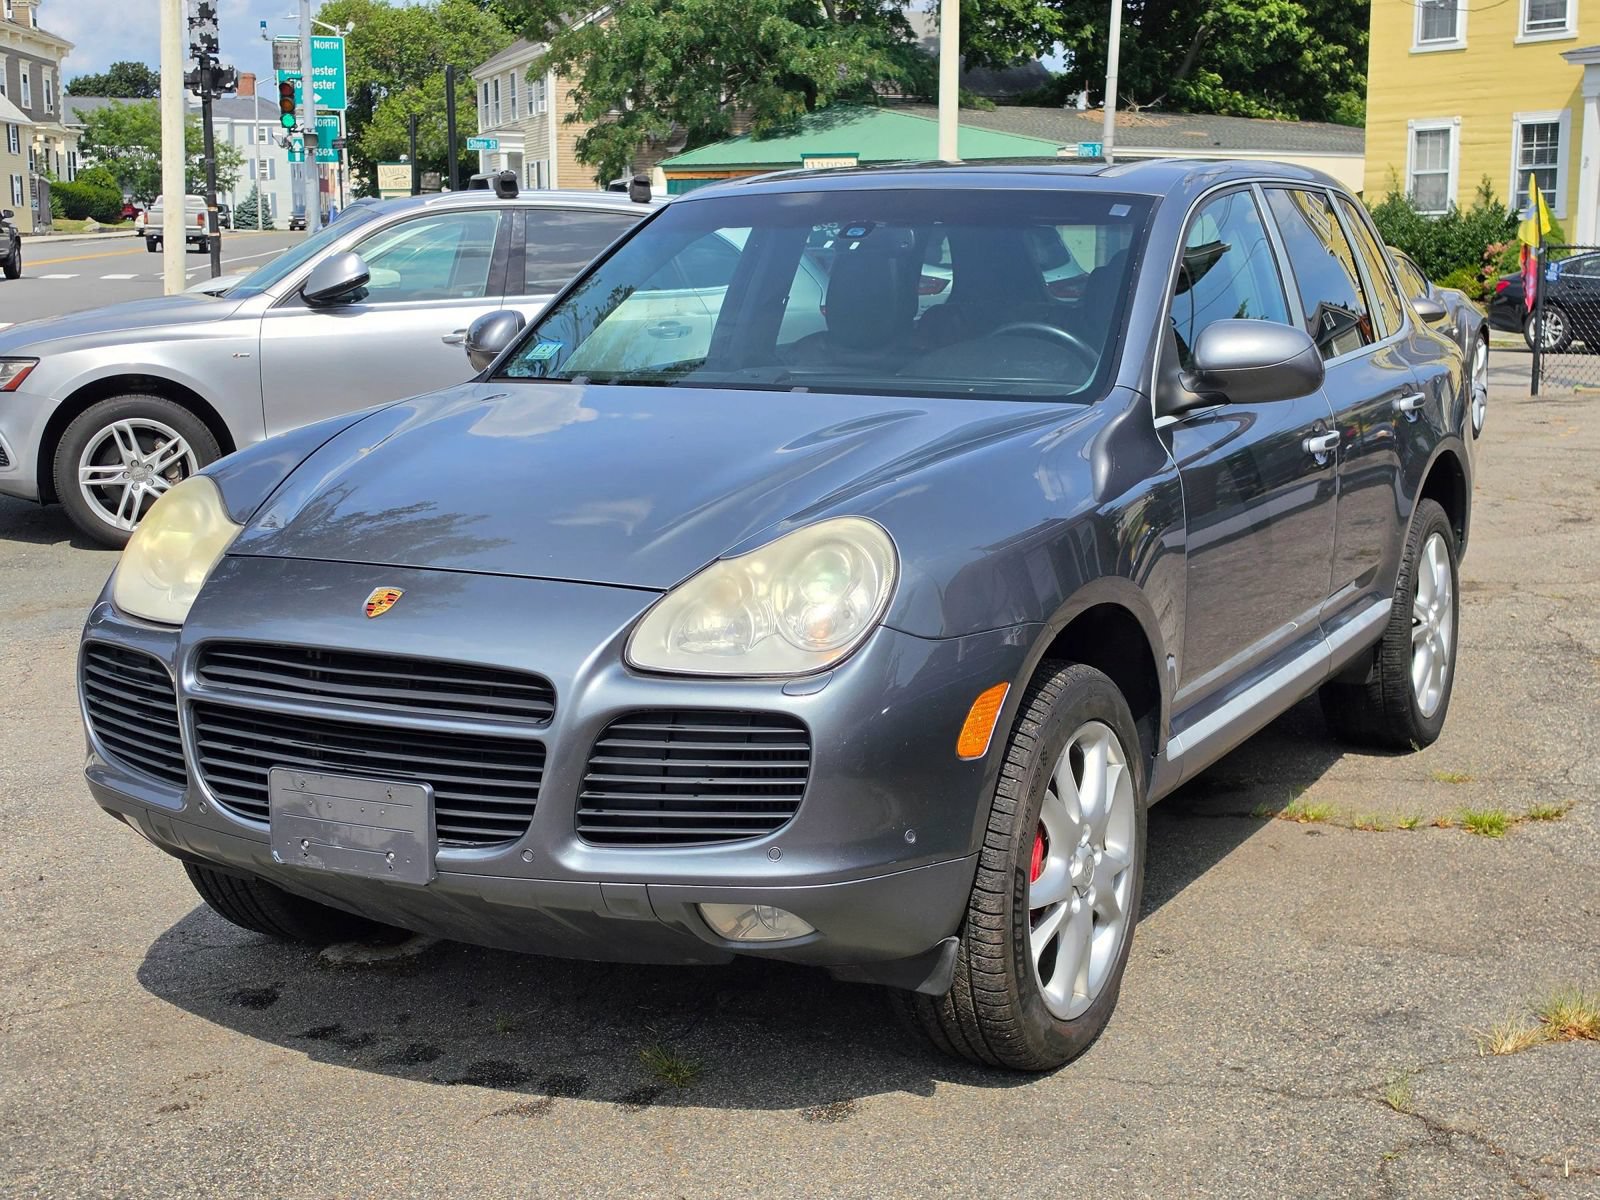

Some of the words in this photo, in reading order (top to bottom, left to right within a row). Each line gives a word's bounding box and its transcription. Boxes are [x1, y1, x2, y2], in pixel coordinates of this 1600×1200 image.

[313, 40, 339, 49] NORTH
[315, 148, 334, 156] ssex
[1014, 872, 1026, 978] MICHELIN
